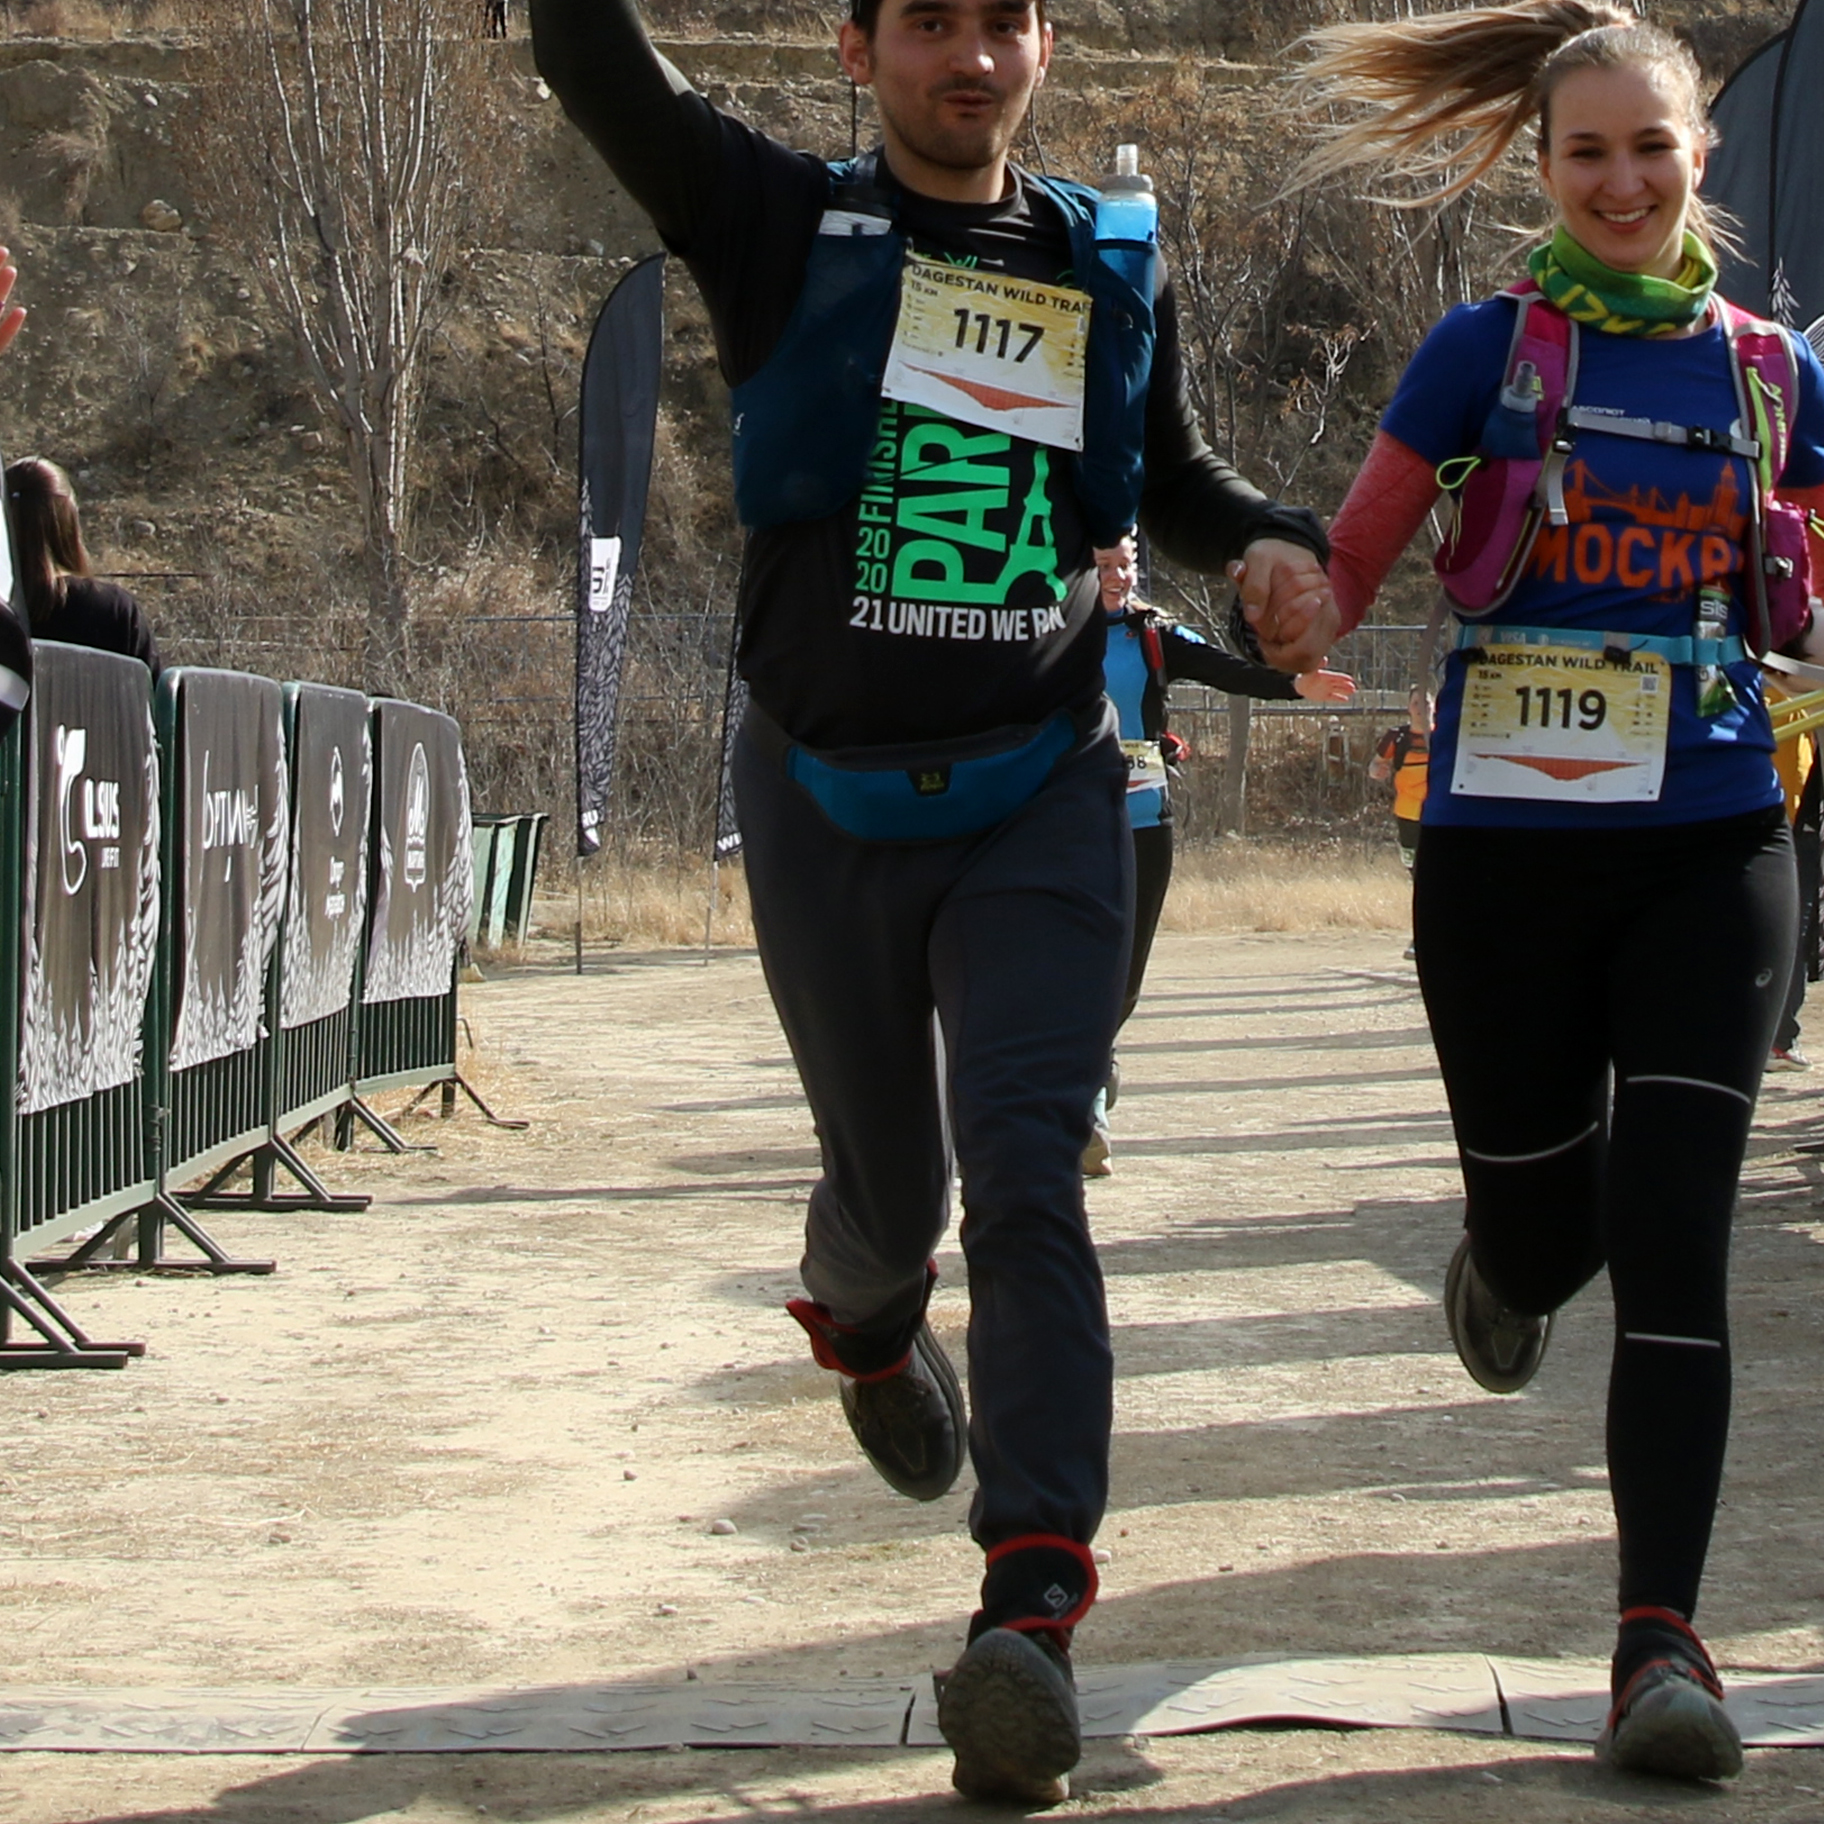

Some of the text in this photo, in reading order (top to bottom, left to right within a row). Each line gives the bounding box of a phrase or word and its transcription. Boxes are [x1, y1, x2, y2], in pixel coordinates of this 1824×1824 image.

[910, 263, 999, 296] DAGESTAN
[1003, 285, 1047, 307] WILD
[953, 307, 1046, 365] 1117
[849, 594, 883, 632] 21
[887, 601, 987, 641] UNITED
[991, 608, 1030, 642] WE
[1562, 655, 1606, 671] WILD
[1612, 659, 1660, 675] TRAIL
[1515, 685, 1607, 731] 1119
